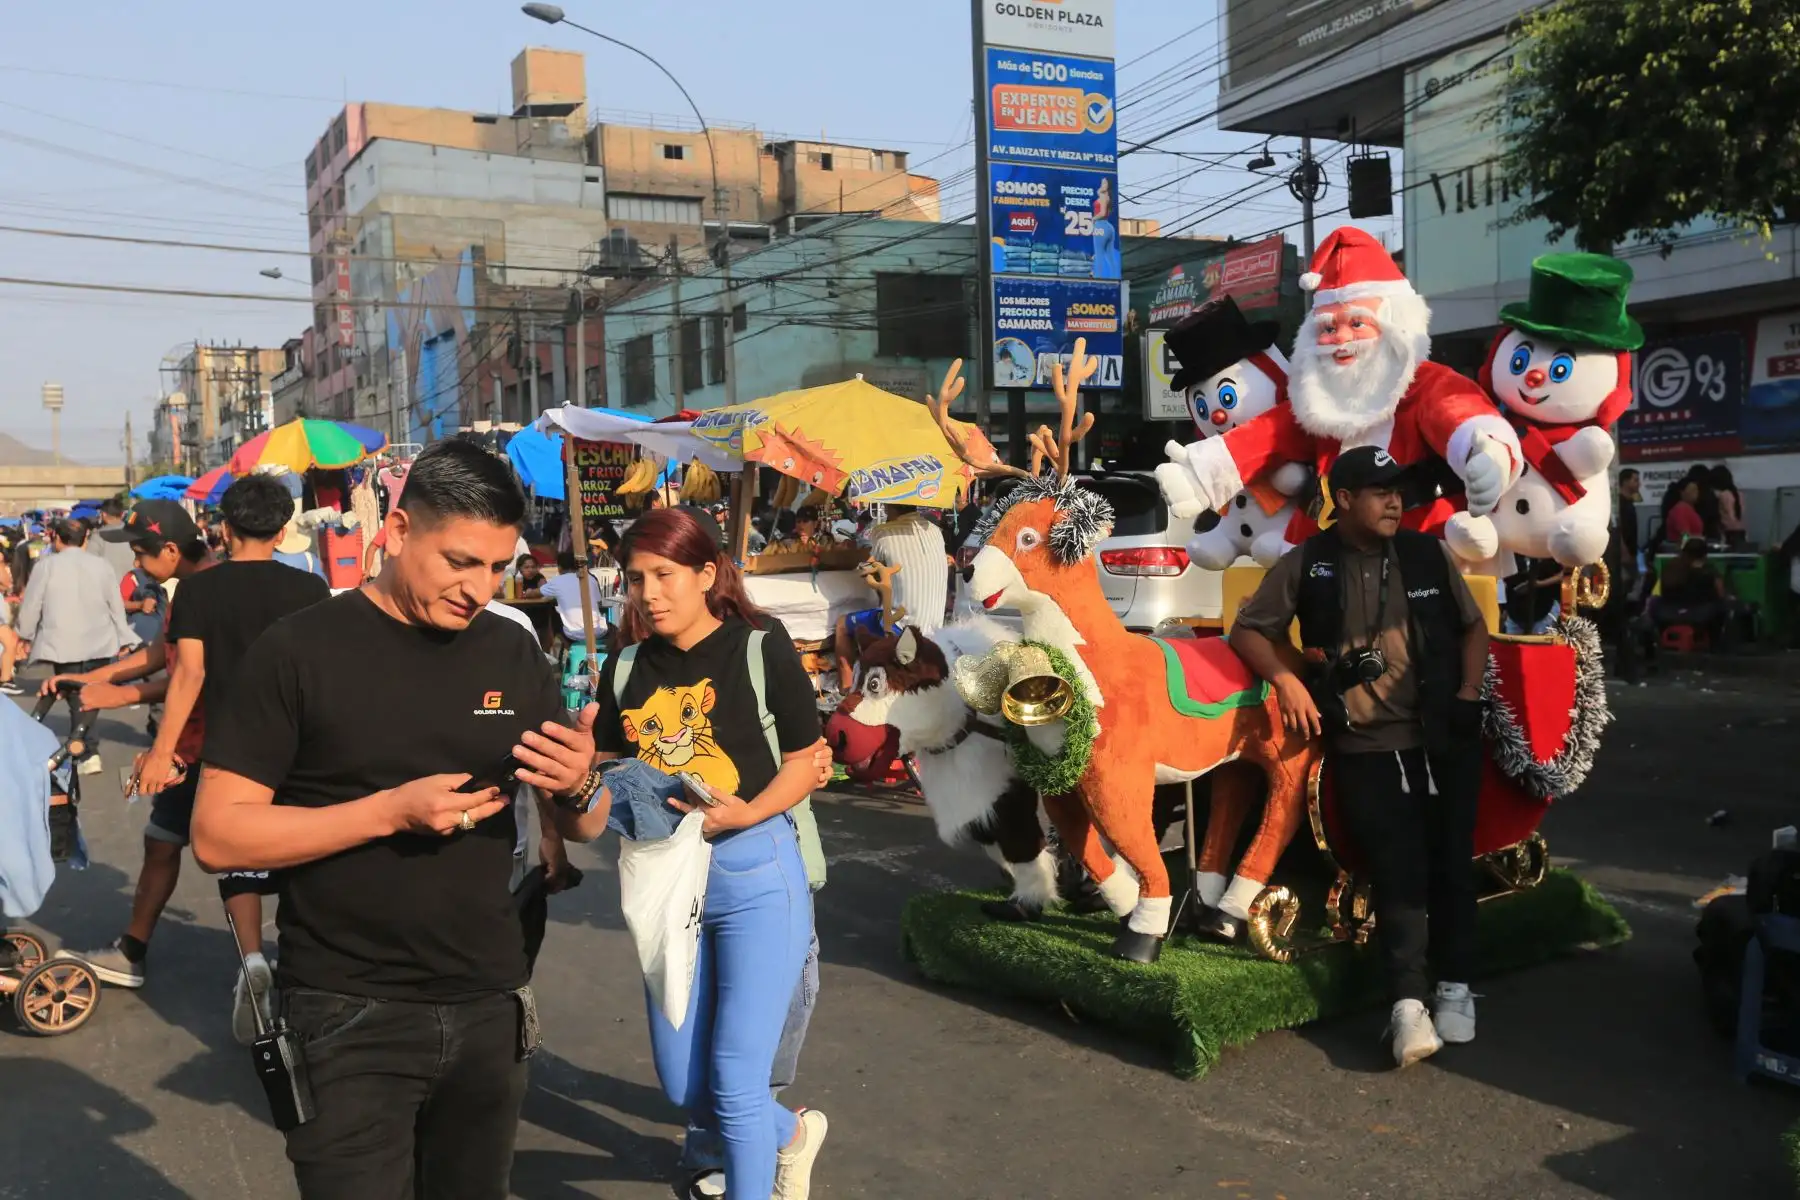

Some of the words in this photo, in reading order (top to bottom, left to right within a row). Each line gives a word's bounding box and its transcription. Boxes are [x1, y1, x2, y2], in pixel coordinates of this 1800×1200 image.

[995, 2, 1054, 21] GOLDEN
[1058, 11, 1104, 28] PLAZA
[997, 59, 1018, 72] Más
[1018, 63, 1031, 73] de
[1032, 61, 1068, 82] 500
[1069, 67, 1104, 81] tiendas
[1000, 91, 1077, 108] EXPERTOS
[1001, 106, 1015, 117] EN
[1014, 110, 1077, 127] JEANS
[992, 144, 1009, 155] AV.
[1009, 146, 1050, 158] BAUZATE
[1049, 150, 1058, 159] Y
[1057, 151, 1083, 161] MEZA
[996, 180, 1047, 196] SOMOS
[1060, 185, 1094, 197] PRECIOS
[1065, 196, 1090, 207] DESDE
[1156, 283, 1195, 305] GAMARRA
[999, 296, 1015, 305] LOS
[1014, 297, 1050, 306] MEJORES
[999, 307, 1037, 317] PRECIOS
[1039, 308, 1051, 318] DE
[1149, 303, 1193, 324] NAVIDAD
[998, 319, 1053, 331] GAMARRA
[1695, 354, 1727, 402] 93
[1161, 404, 1187, 414] TAXIS
[588, 466, 624, 478] FRITO
[580, 492, 607, 504] UCA
[579, 505, 625, 517] SALADA
[1407, 587, 1440, 599] Fotógrafo
